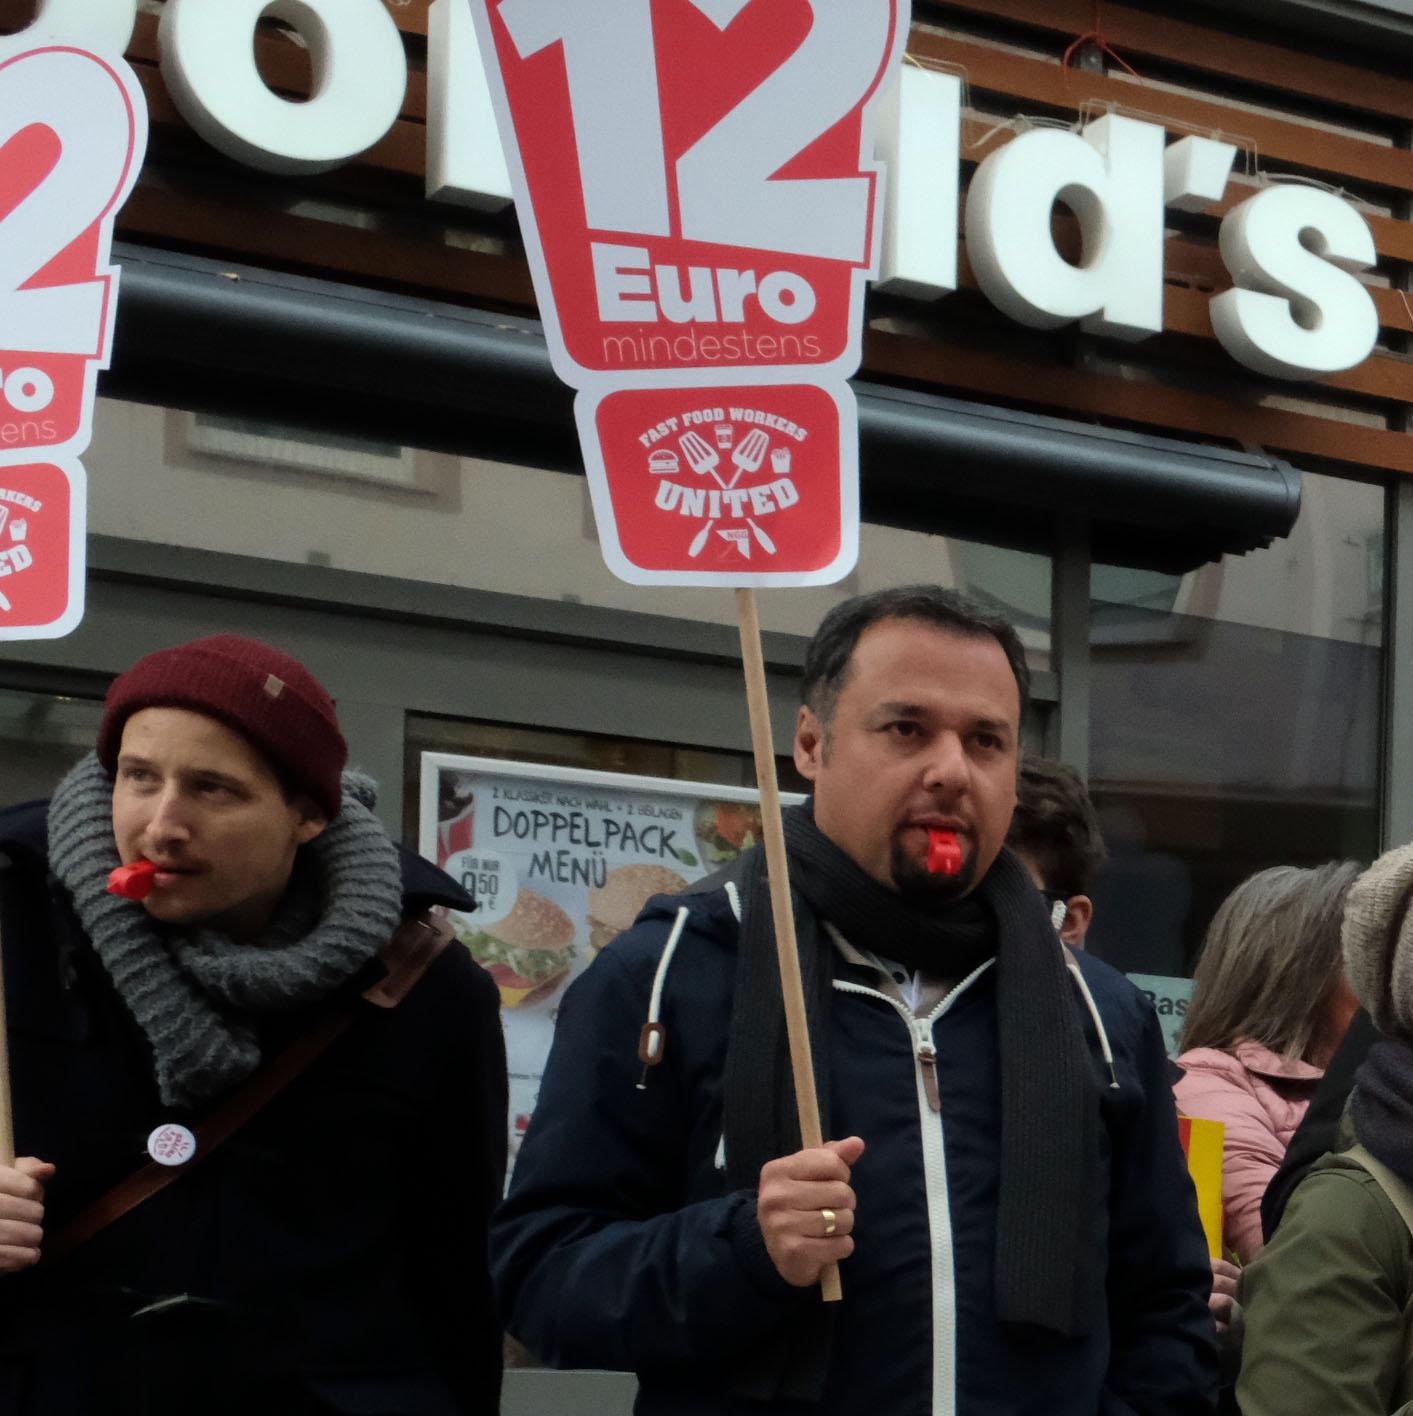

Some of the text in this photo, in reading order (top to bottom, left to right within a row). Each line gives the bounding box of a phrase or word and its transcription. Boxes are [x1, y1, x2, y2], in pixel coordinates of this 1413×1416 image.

[497, 0, 889, 263] 12
[0, 48, 133, 356] 2
[590, 242, 816, 324] Euro
[602, 328, 821, 363] mindestens
[639, 407, 808, 448] FAST FOOD WORKERS
[654, 477, 799, 519] UNITED
[493, 806, 680, 861] DOPPELPACK
[528, 849, 608, 890] MENÜ
